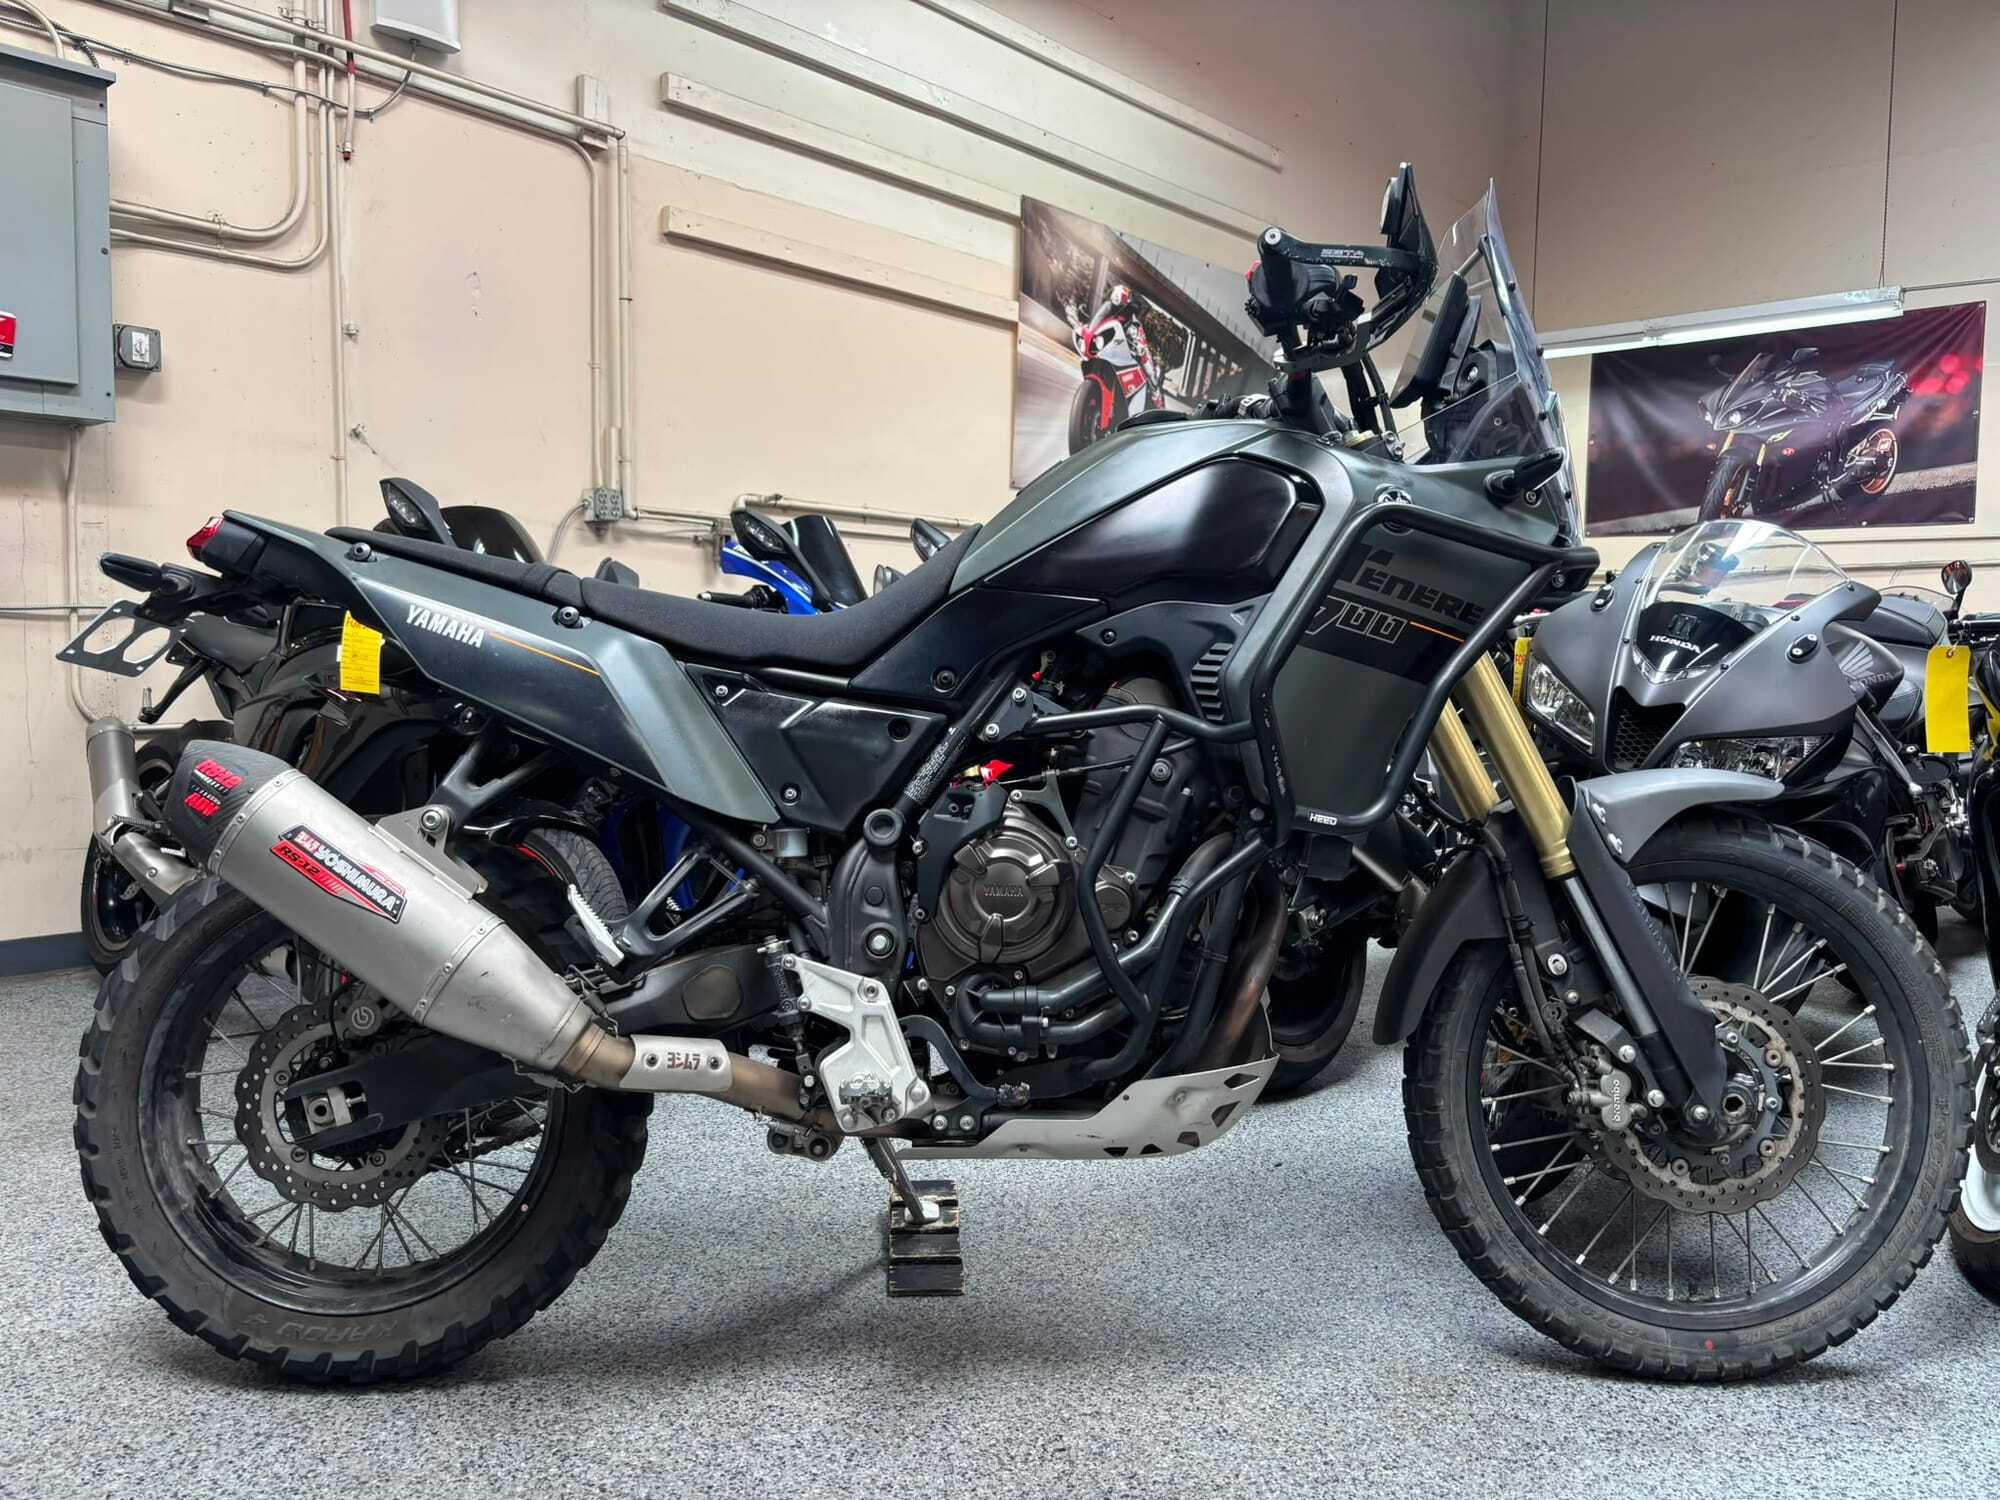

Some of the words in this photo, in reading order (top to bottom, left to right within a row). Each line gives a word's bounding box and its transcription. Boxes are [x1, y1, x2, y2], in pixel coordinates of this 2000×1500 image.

[406, 603, 485, 649] YAMAHA
[1304, 594, 1408, 644] 700
[1649, 634, 1701, 655] HONDA
[1309, 812, 1338, 826] HEED
[279, 845, 321, 876] RS-12
[313, 844, 398, 913] YOSHIMURA
[983, 885, 1024, 898] YAMAHA
[667, 1051, 701, 1071] ヨシムラ
[1610, 1079, 1621, 1122] brembo
